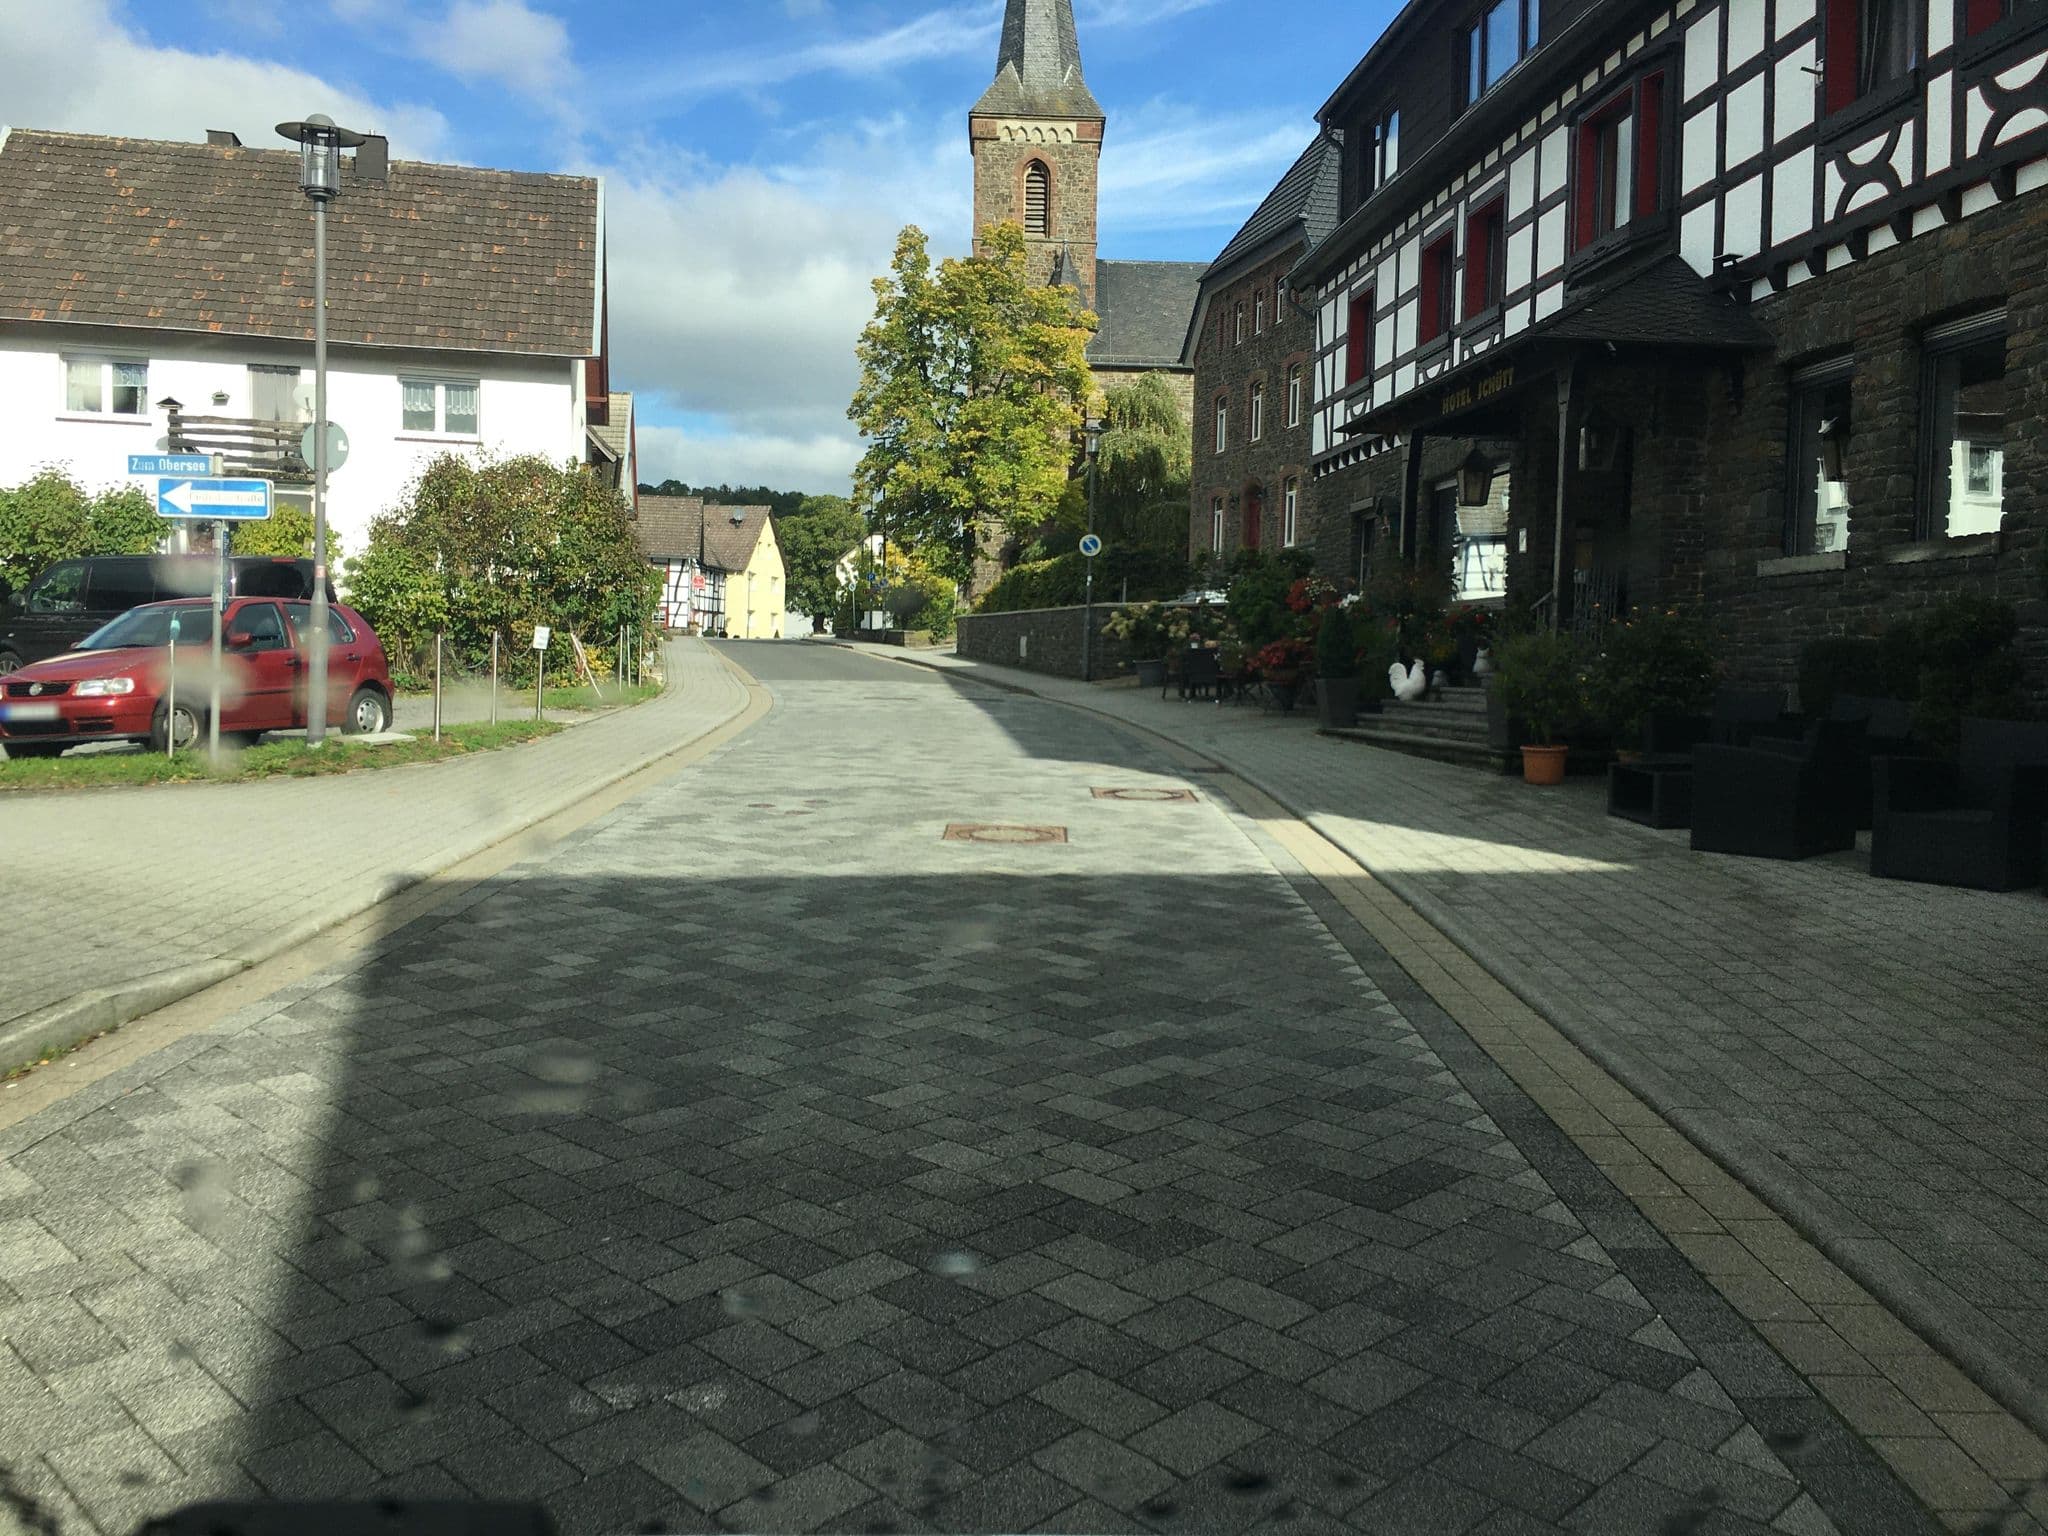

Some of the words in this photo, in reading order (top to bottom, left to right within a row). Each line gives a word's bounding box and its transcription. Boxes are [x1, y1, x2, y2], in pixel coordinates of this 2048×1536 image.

[1442, 387, 1472, 415] HOTEL
[1477, 368, 1514, 400] SCHÜTT
[132, 457, 155, 471] Zum
[158, 458, 206, 472] Obersee
